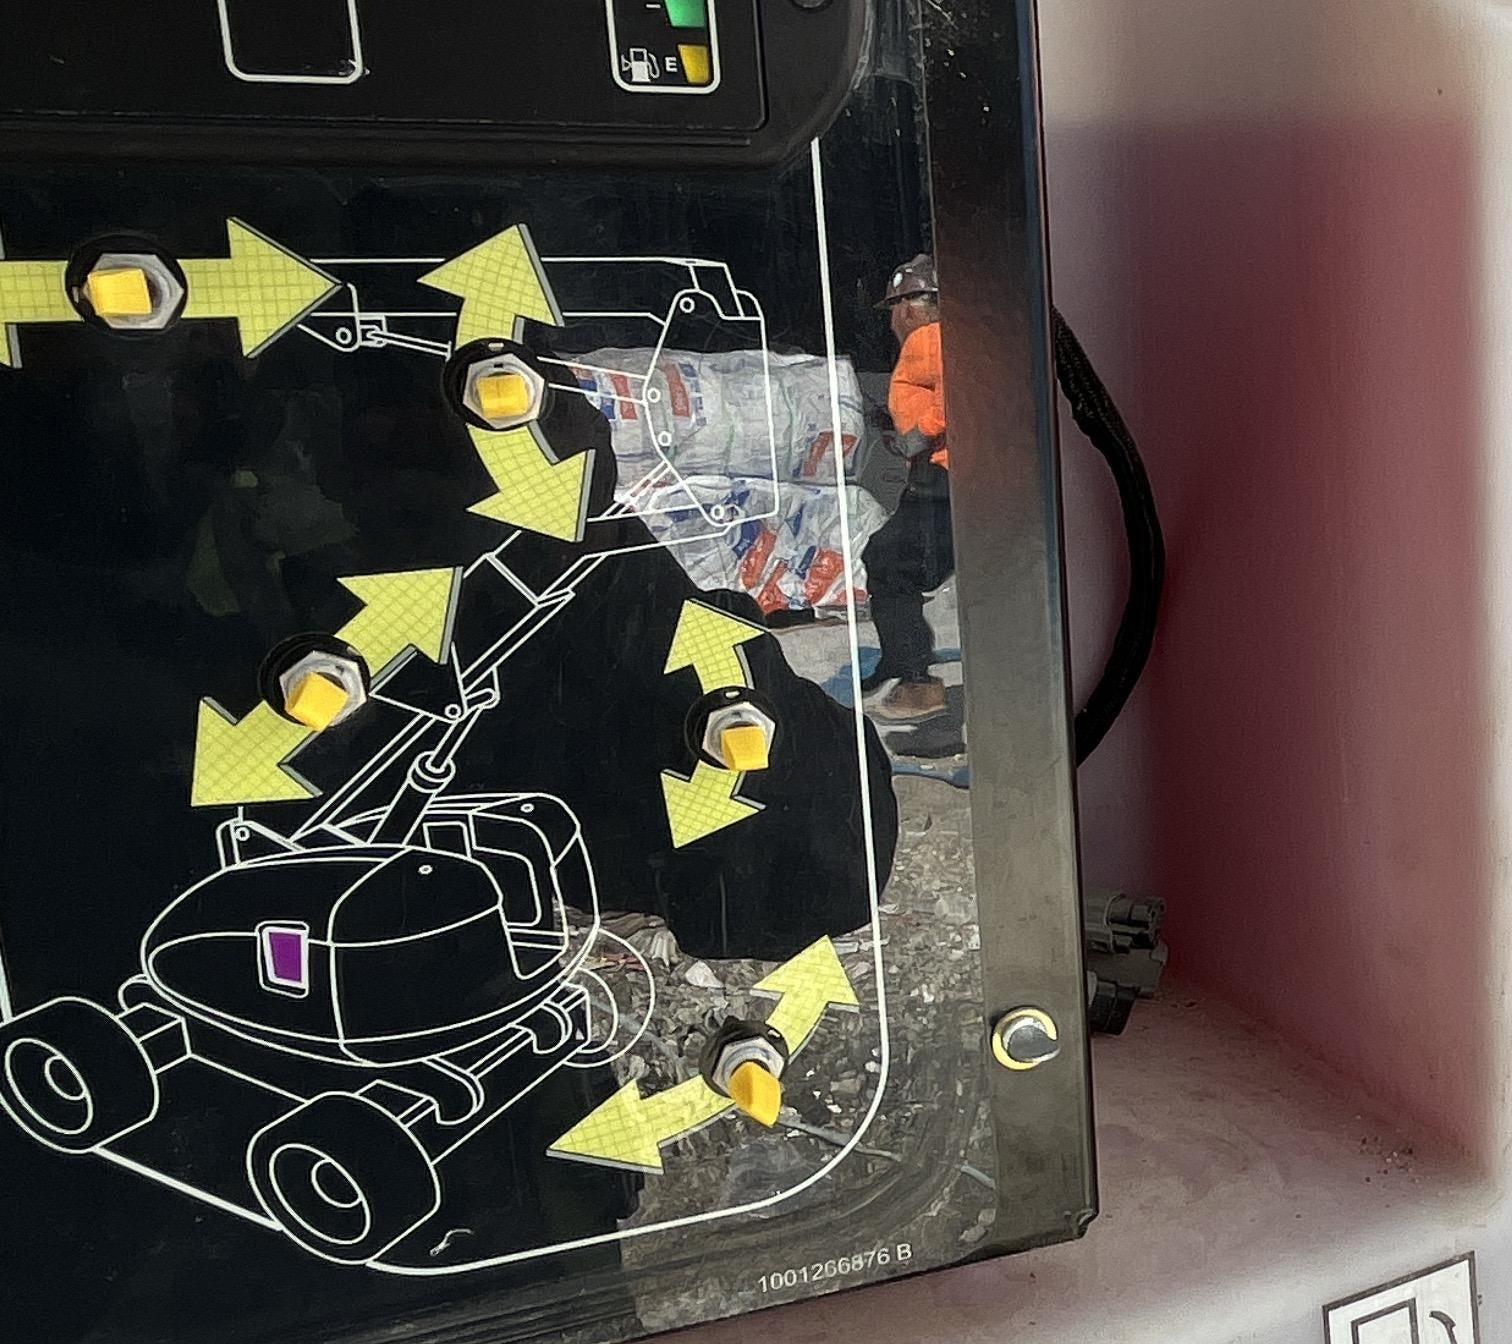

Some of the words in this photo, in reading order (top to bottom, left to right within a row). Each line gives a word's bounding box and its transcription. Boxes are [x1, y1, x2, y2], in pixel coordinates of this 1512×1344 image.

[664, 56, 678, 73] E
[757, 1246, 891, 1293] 1001266876
[896, 1243, 912, 1262] B
